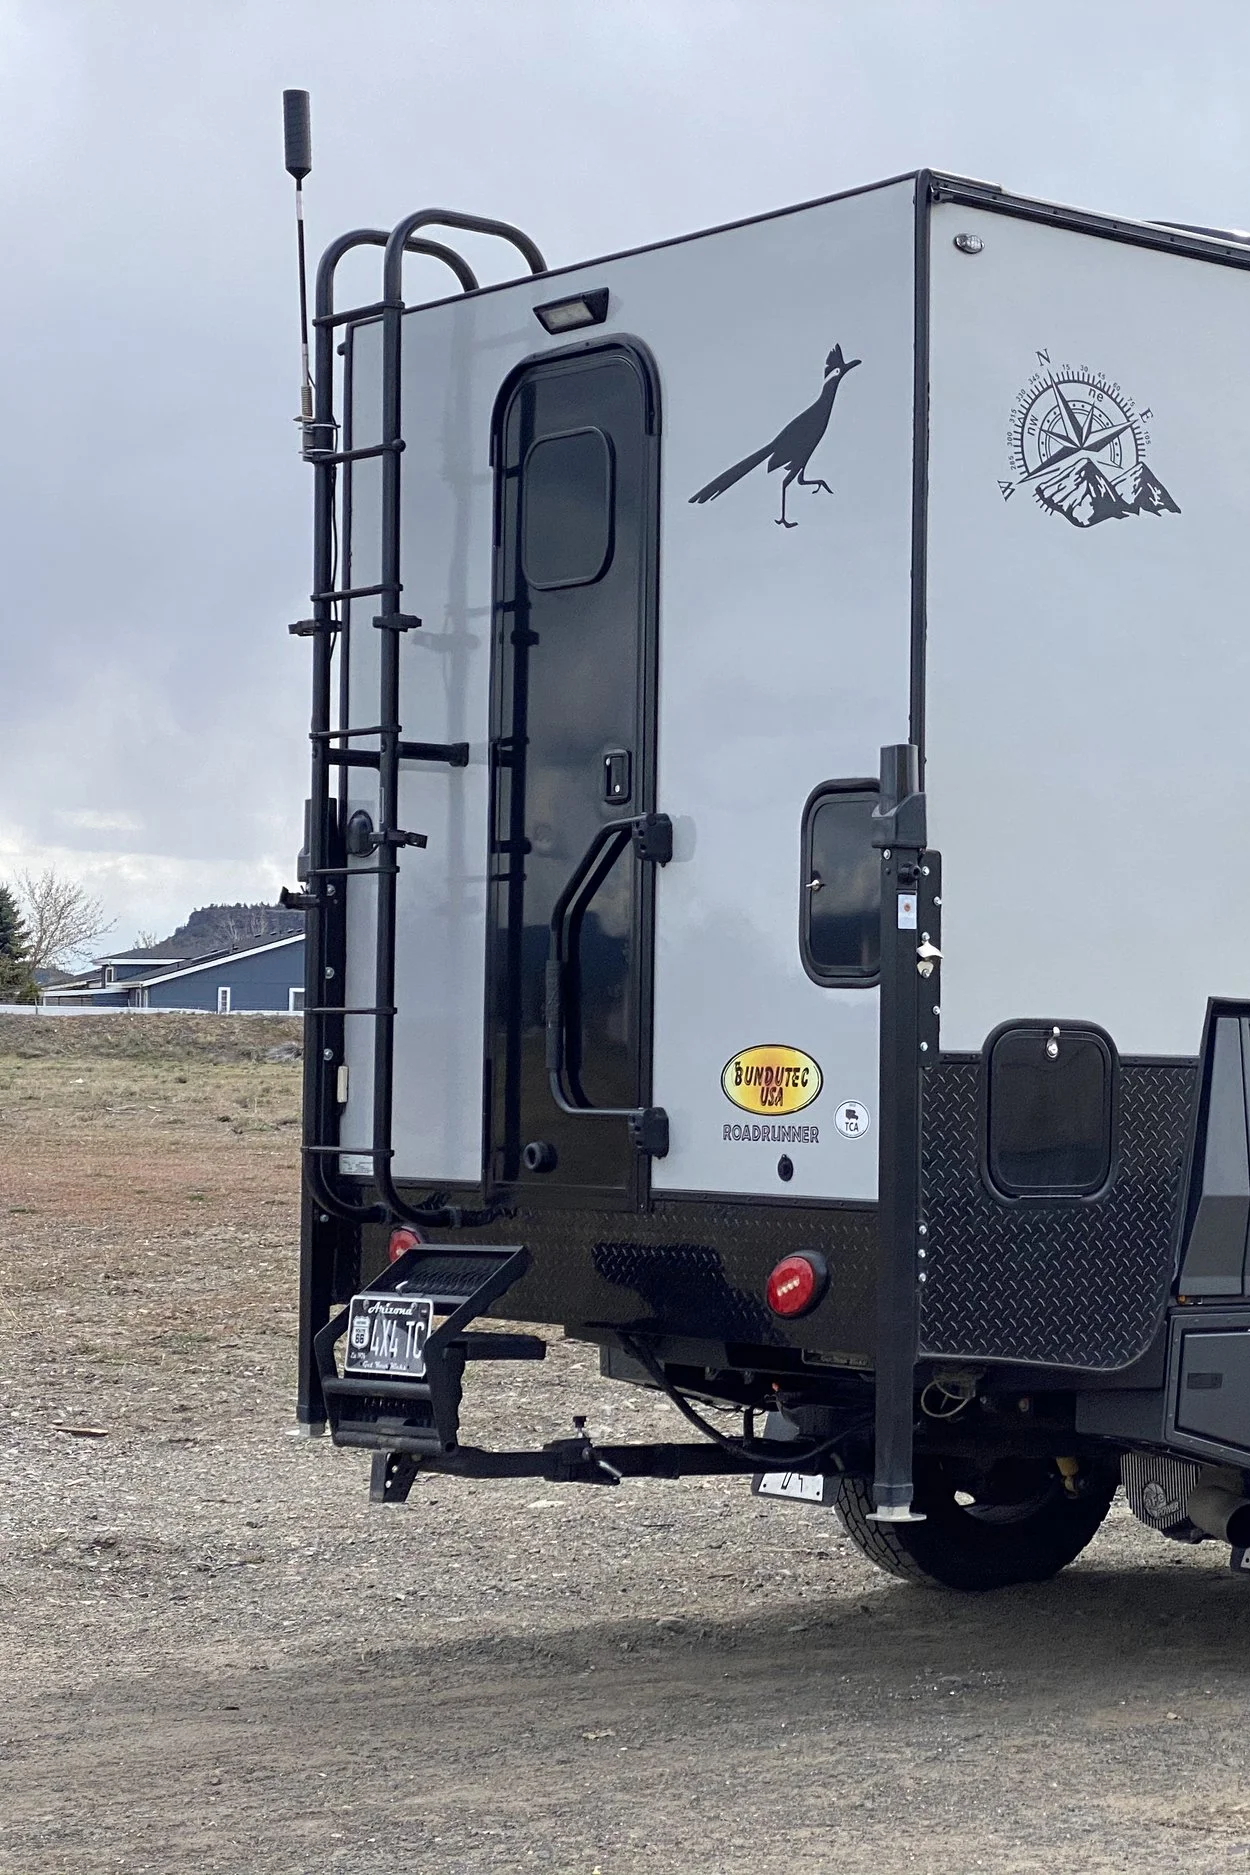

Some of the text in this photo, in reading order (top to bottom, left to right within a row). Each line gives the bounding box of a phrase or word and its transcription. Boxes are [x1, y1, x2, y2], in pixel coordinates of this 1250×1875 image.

[1035, 348, 1051, 367] N
[1062, 363, 1071, 371] 15
[1079, 364, 1089, 373] 30
[1027, 373, 1041, 385] 345
[1015, 388, 1027, 403] 330
[1008, 408, 1018, 424] 315
[1138, 407, 1154, 424] E
[996, 479, 1016, 502] W
[734, 1061, 810, 1087] BUNDUTEC
[760, 1086, 784, 1107] USA
[722, 1124, 820, 1144] ROADRUNNER
[845, 1121, 859, 1132] TCA
[368, 1301, 413, 1315] Arizona
[355, 1333, 365, 1344] 66
[370, 1318, 425, 1359] 4X4 TC
